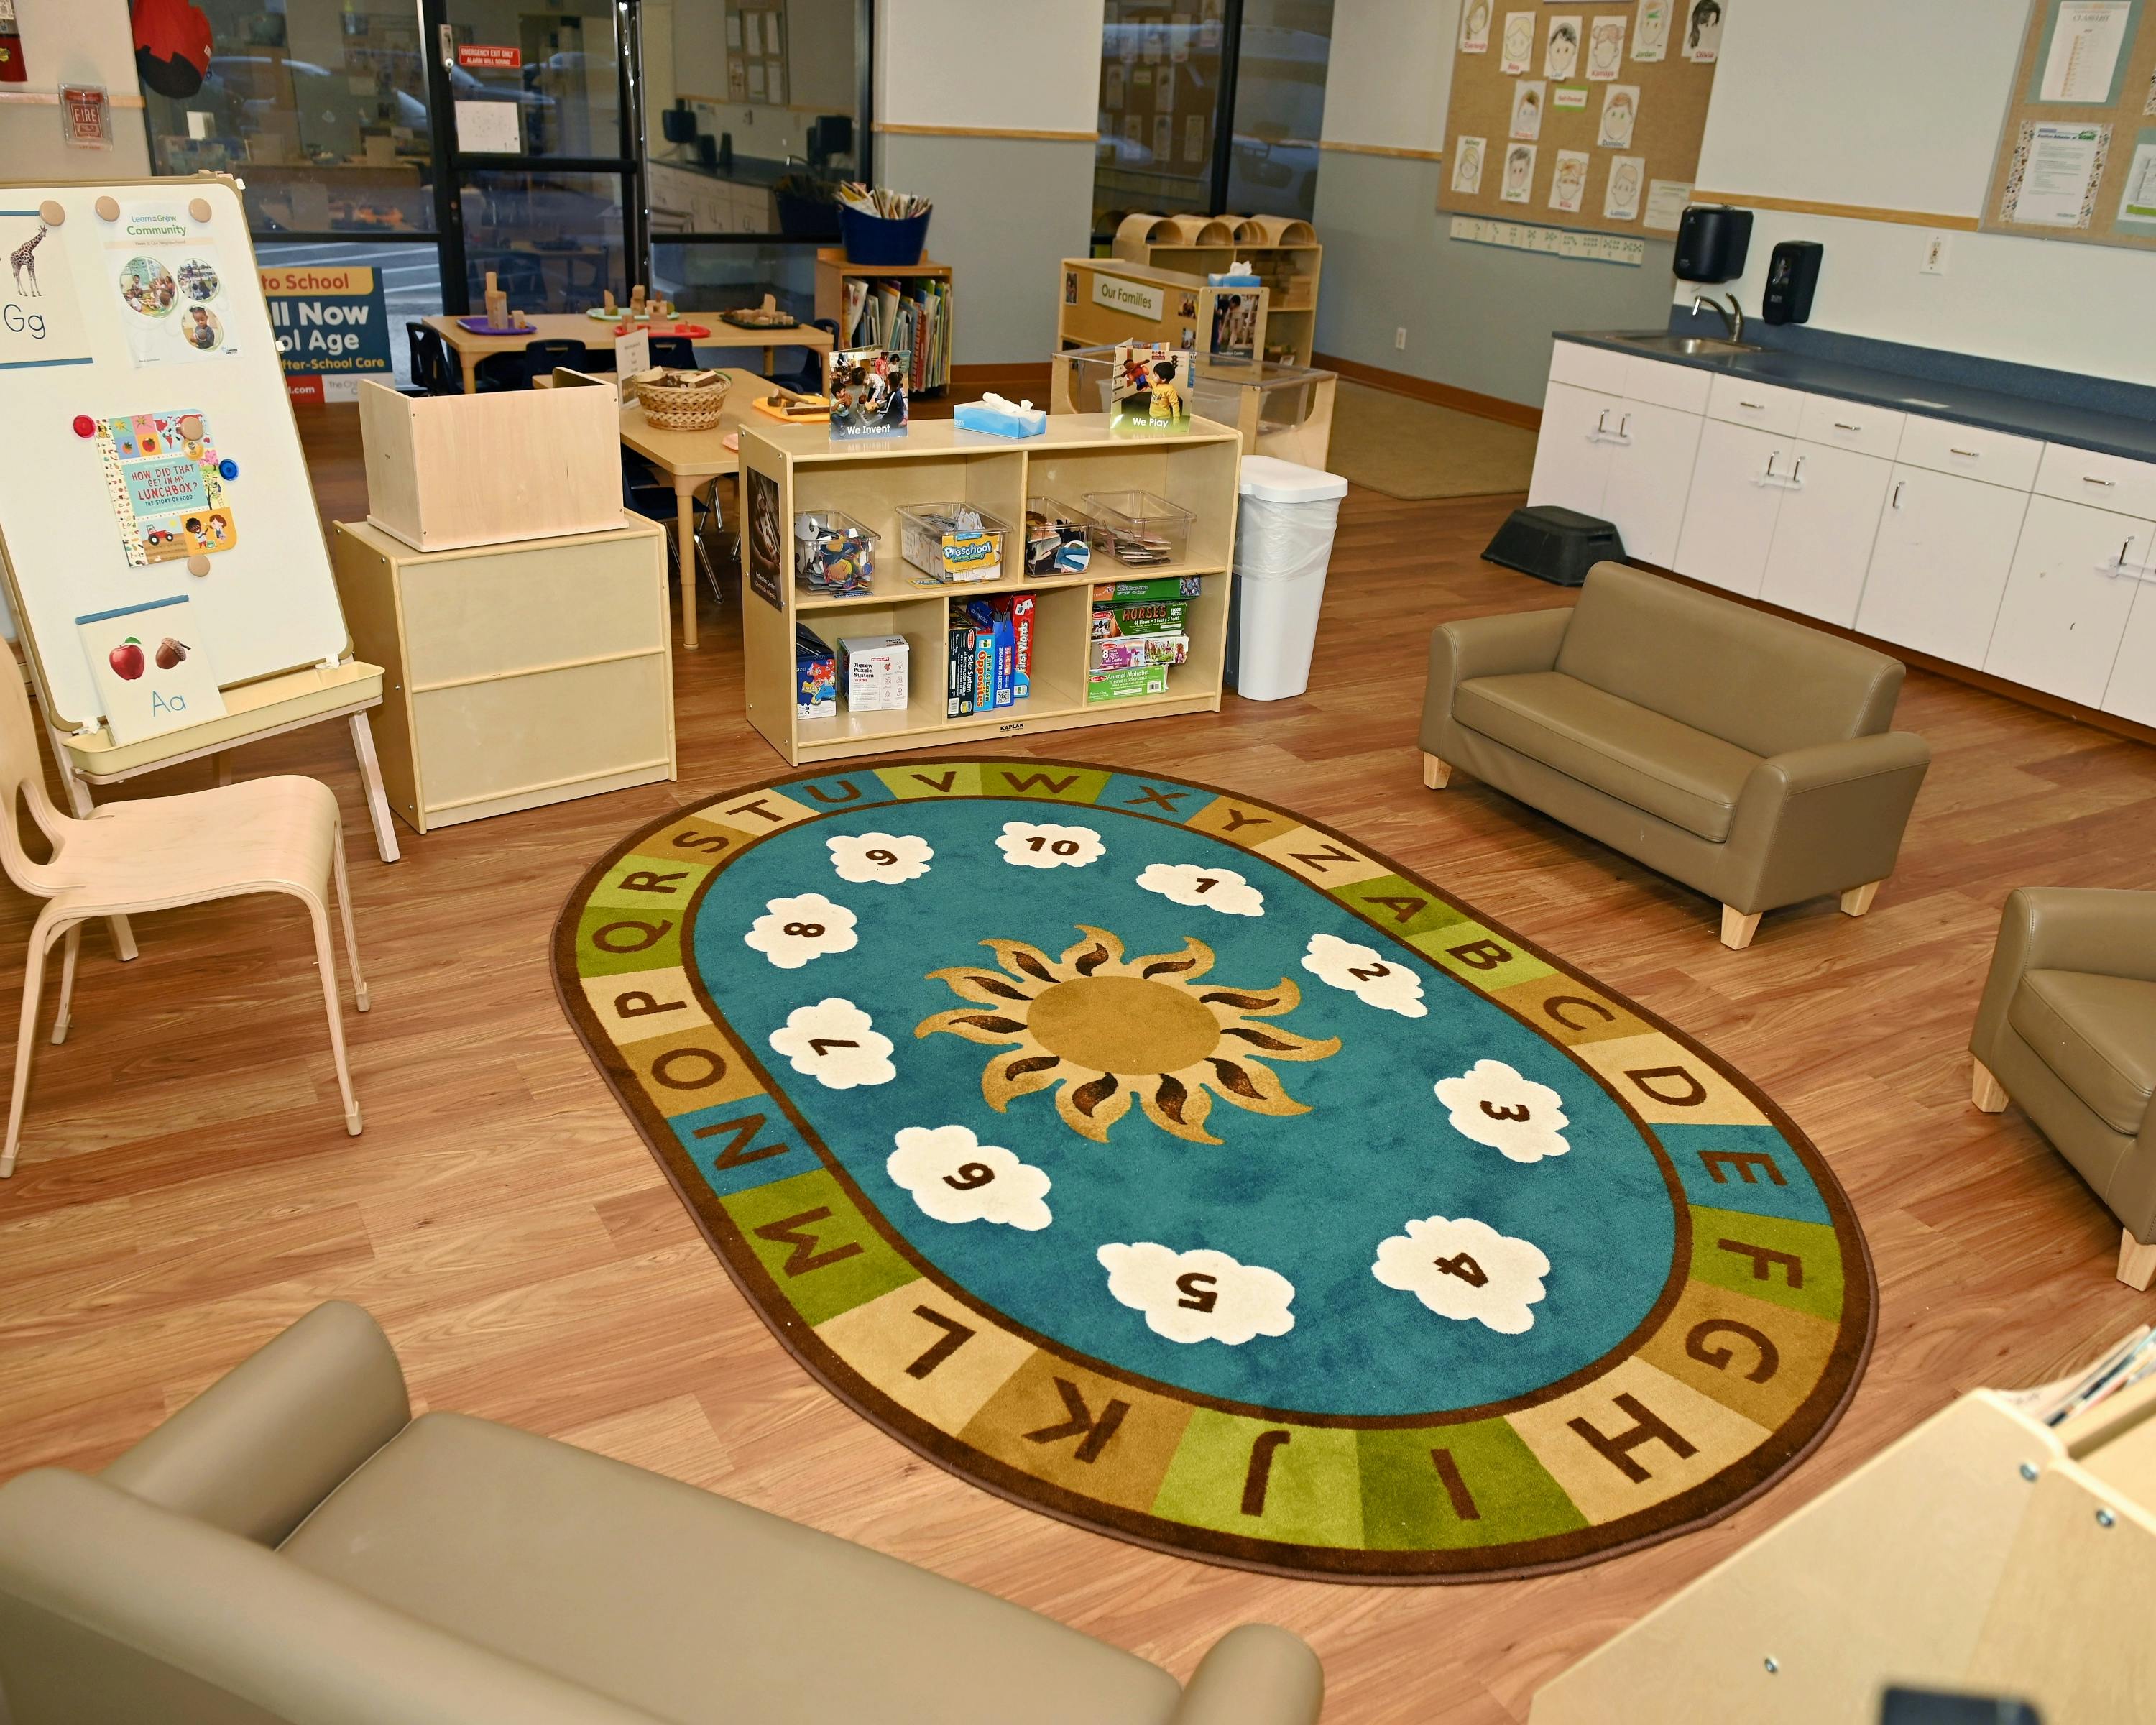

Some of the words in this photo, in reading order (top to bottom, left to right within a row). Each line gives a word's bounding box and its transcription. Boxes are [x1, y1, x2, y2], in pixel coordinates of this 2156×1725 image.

[461, 47, 489, 57] EMERGENCY
[490, 49, 501, 58] EXIT
[501, 50, 513, 58] ONLY
[74, 109, 98, 121] FIRE
[126, 224, 187, 236] Community
[262, 275, 281, 290] to
[285, 273, 349, 290] School
[1102, 285, 1117, 299] Our
[1118, 288, 1152, 309] Families
[4, 304, 46, 339] Gg
[298, 301, 369, 326] Now
[308, 330, 359, 356] Age
[355, 357, 385, 368] Care
[847, 426, 861, 436] We
[862, 423, 890, 434] Invent
[1133, 418, 1147, 426] We
[1149, 418, 1169, 428] Play
[131, 470, 151, 482] HOW
[155, 467, 171, 478] DID
[173, 464, 195, 475] THAT
[148, 478, 162, 487] GET
[165, 477, 172, 485] IN
[175, 475, 185, 484] MY
[138, 482, 198, 501] LUNCHBOX?
[155, 497, 171, 506] STORY
[944, 542, 991, 558] Preschool
[1122, 605, 1167, 622] HORSES
[1018, 621, 1029, 652] Words
[1016, 653, 1027, 673] First
[1102, 650, 1109, 658] 8
[977, 651, 987, 707] Opposites
[152, 690, 186, 717] Aa
[805, 779, 861, 804] U
[911, 770, 957, 794] V
[1000, 770, 1080, 796] W
[725, 797, 784, 824] T
[1127, 786, 1187, 812] X
[1222, 807, 1271, 833] Y
[671, 829, 730, 855] S
[1026, 837, 1079, 856] 10
[865, 849, 898, 866] 9
[1289, 842, 1358, 874] Z
[617, 870, 690, 895] R
[1195, 878, 1218, 893] 1
[1362, 895, 1429, 925] A
[591, 918, 675, 955] Q
[783, 922, 826, 938] 8
[1445, 937, 1514, 972] B
[1348, 962, 1391, 982] 2
[613, 990, 688, 1020] P
[1542, 994, 1616, 1033] C
[808, 1038, 860, 1057] 7
[651, 1047, 726, 1090] O
[1625, 1066, 1707, 1107] D
[1480, 1100, 1530, 1123] 3
[694, 1114, 788, 1169] N
[942, 1162, 995, 1191] 6
[1700, 1151, 1786, 1185] E
[753, 1206, 864, 1278] M
[1434, 1252, 1489, 1288] 4
[1717, 1238, 1803, 1289] F
[1176, 1272, 1218, 1313] 5
[906, 1305, 975, 1379] L
[1685, 1319, 1779, 1384] G
[1024, 1376, 1130, 1464] K
[1567, 1393, 1697, 1484] H
[1241, 1430, 1291, 1517] J
